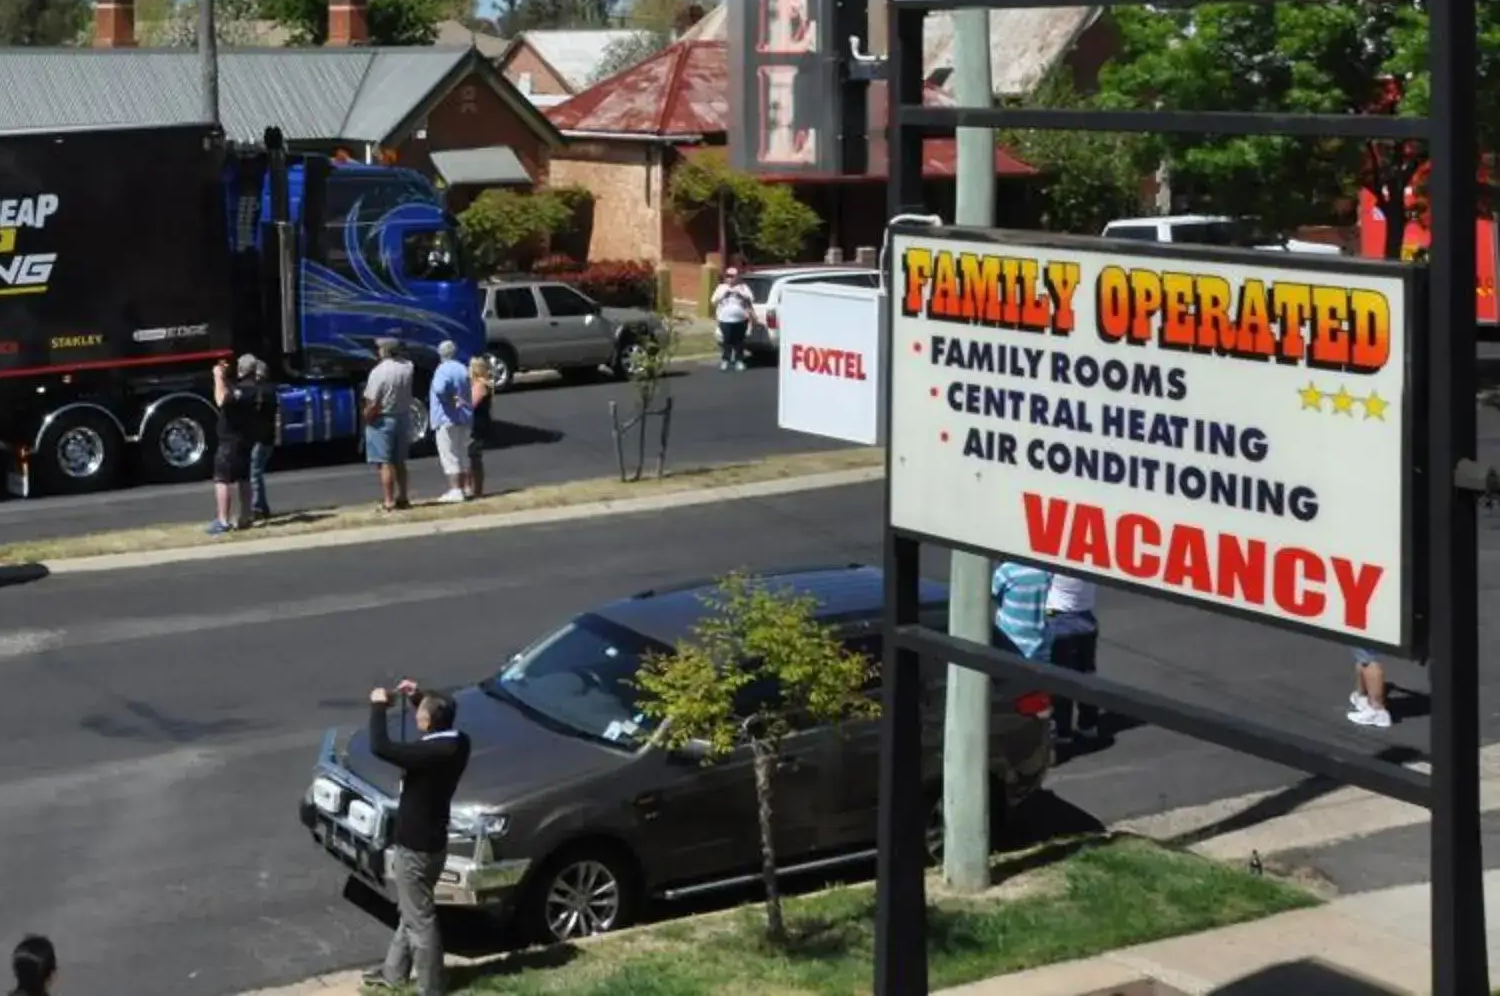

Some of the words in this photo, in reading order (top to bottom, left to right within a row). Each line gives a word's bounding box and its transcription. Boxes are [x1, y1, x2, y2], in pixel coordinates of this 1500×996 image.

[51, 335, 104, 349] STANLEY
[901, 247, 1081, 336] FAMILY
[1095, 264, 1391, 375] OPERATED
[791, 344, 867, 381] FOXTEL
[931, 335, 1045, 379] FAMILY
[1051, 351, 1187, 400] ROOMS
[947, 381, 1093, 433] CENTRAL
[1102, 404, 1269, 462] HEATING
[963, 428, 1018, 466] AIR
[1026, 438, 1319, 521] CONDITIONING
[1023, 492, 1384, 630] VACANCY
